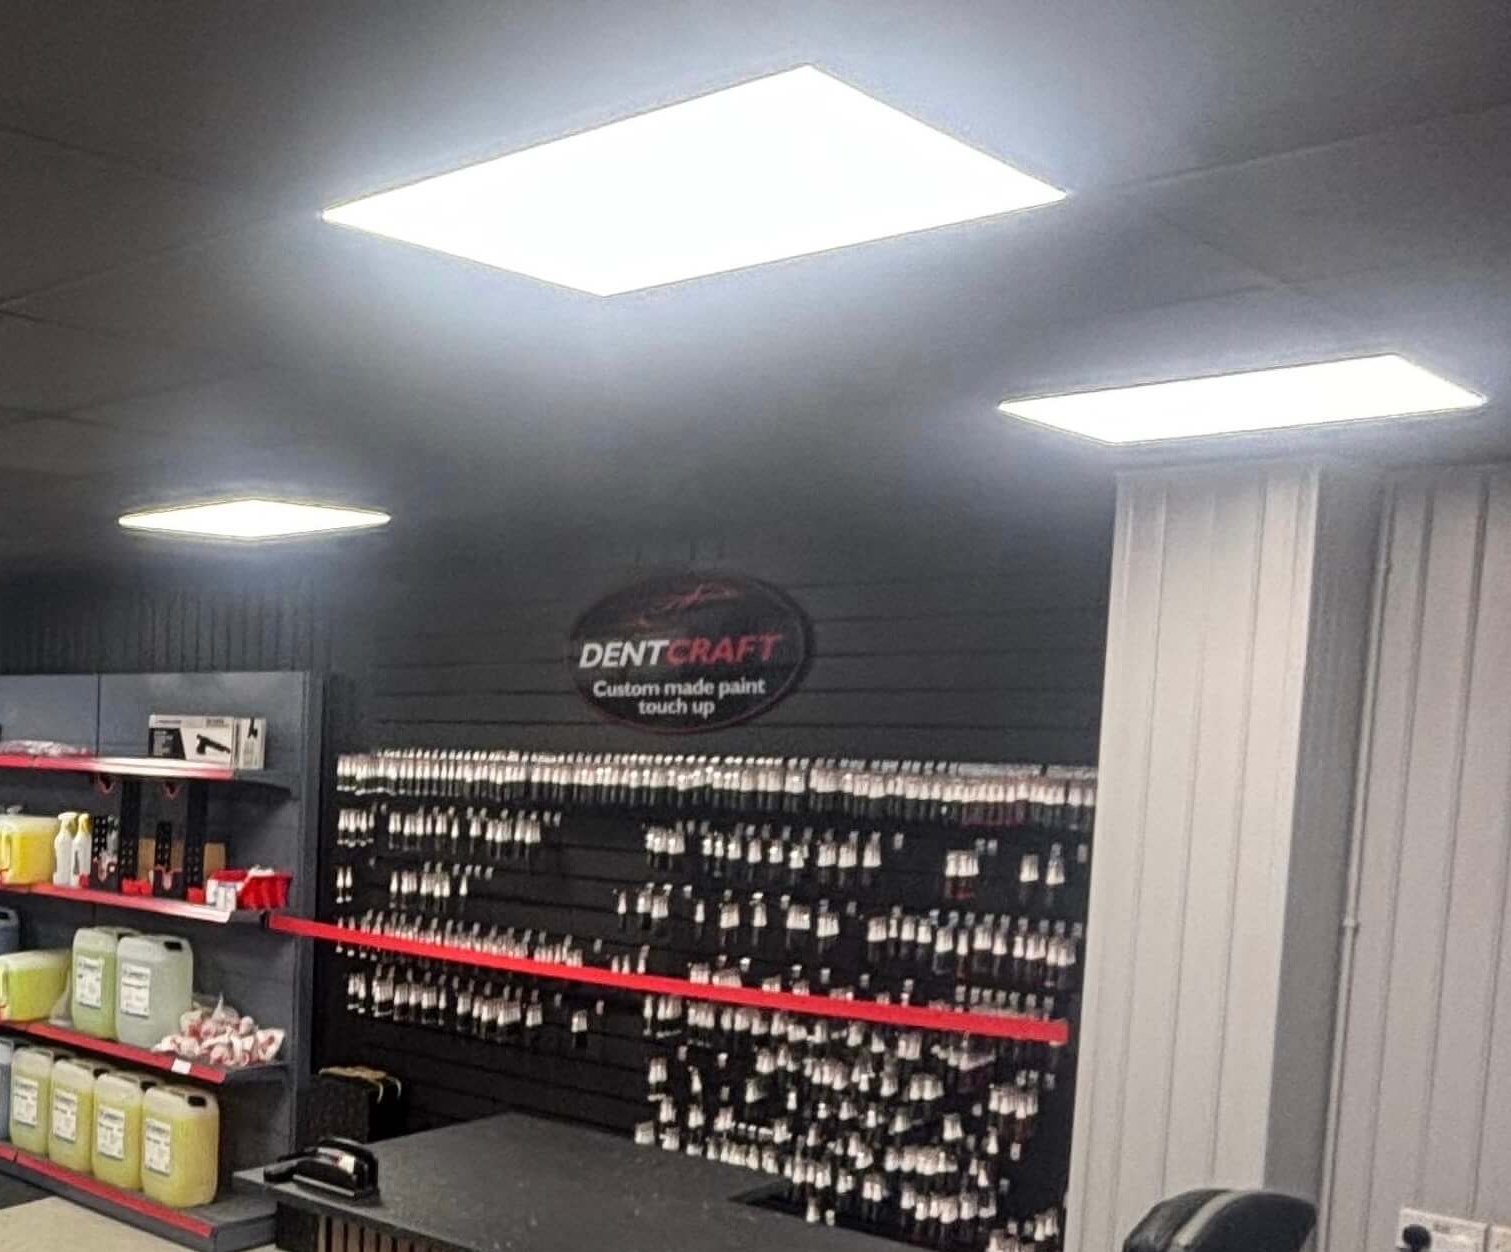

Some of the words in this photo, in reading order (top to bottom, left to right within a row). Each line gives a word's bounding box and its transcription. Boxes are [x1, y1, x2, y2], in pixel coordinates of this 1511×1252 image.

[578, 633, 784, 669] DENTCRAFT
[593, 680, 660, 698] Custom
[663, 677, 715, 697] made
[718, 676, 766, 703] paint
[638, 697, 688, 715] touch
[692, 700, 716, 720] up
